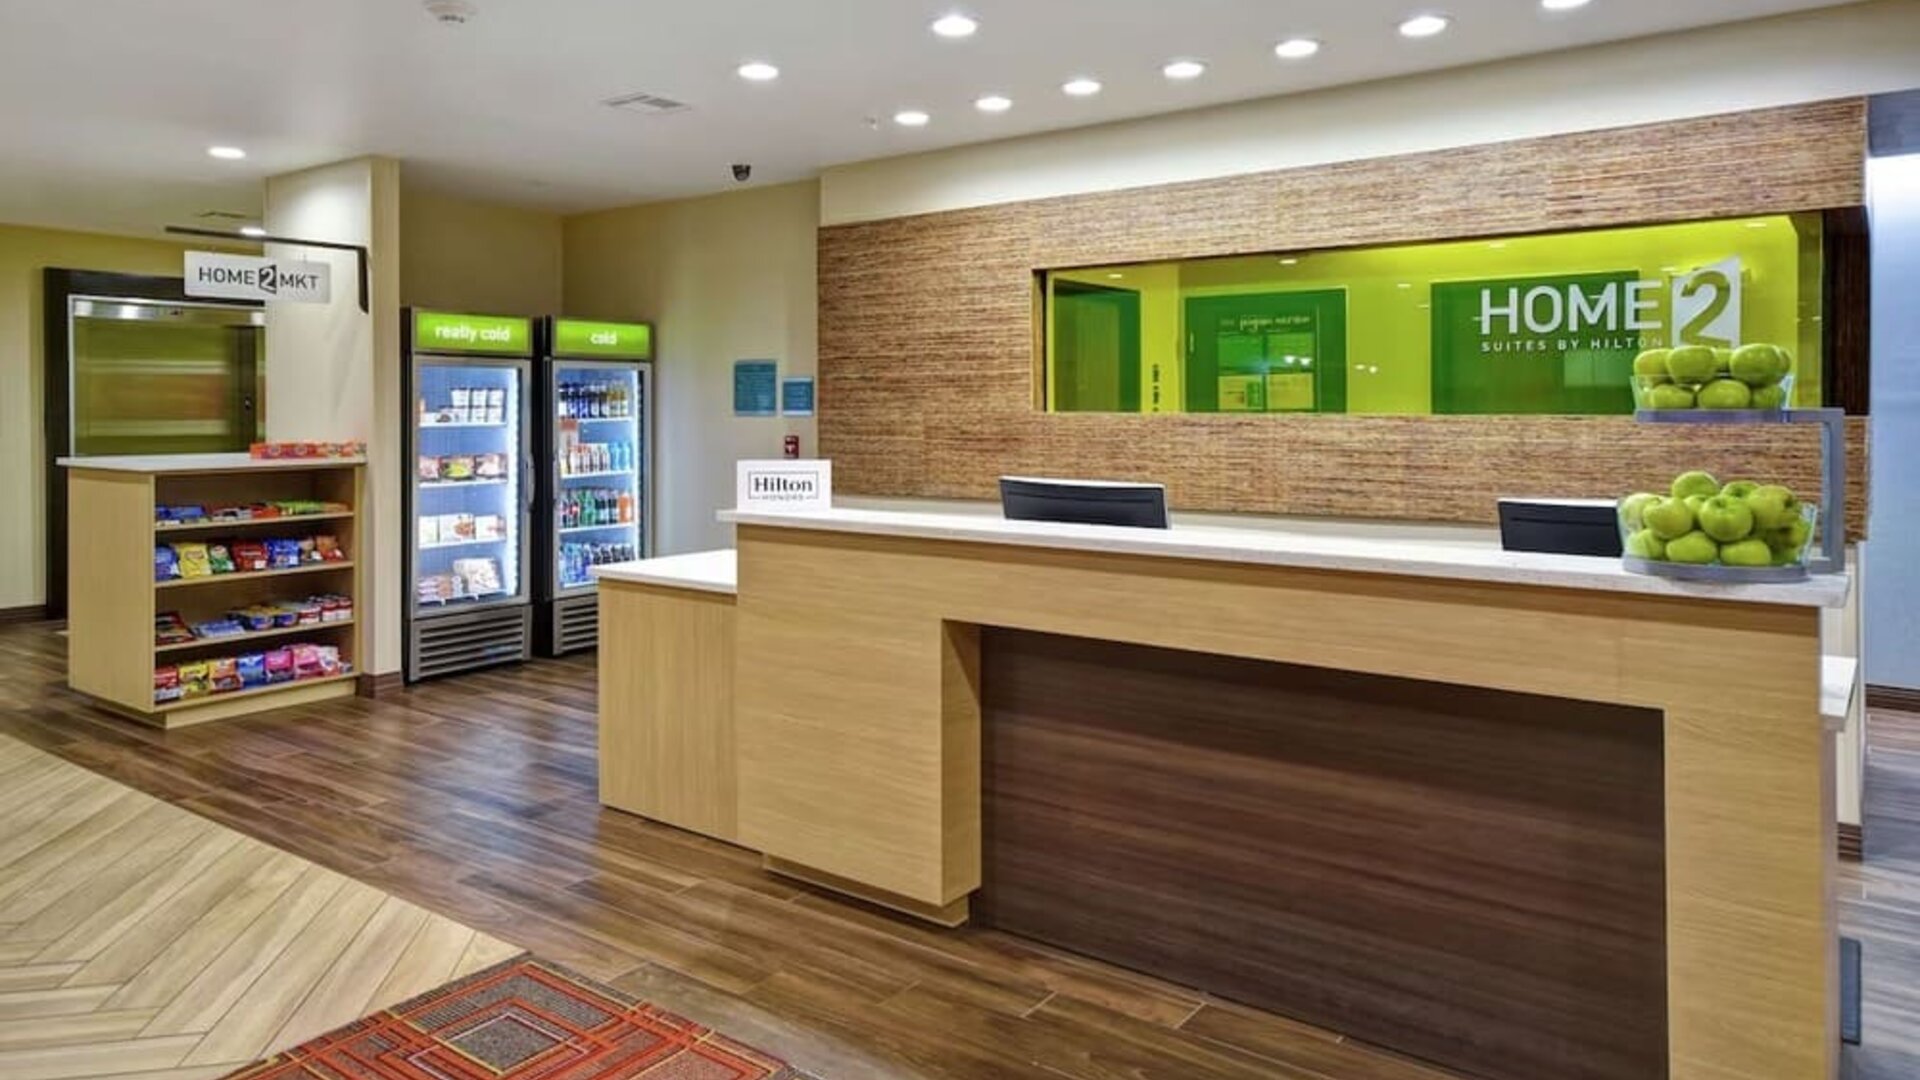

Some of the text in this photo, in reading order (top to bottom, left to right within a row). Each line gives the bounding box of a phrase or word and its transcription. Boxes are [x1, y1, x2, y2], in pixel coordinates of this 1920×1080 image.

[435, 324, 511, 343] really cold
[590, 330, 618, 345] cold
[1481, 336, 1663, 352] SUITES BY HILTON
[754, 476, 813, 492] Hilton
